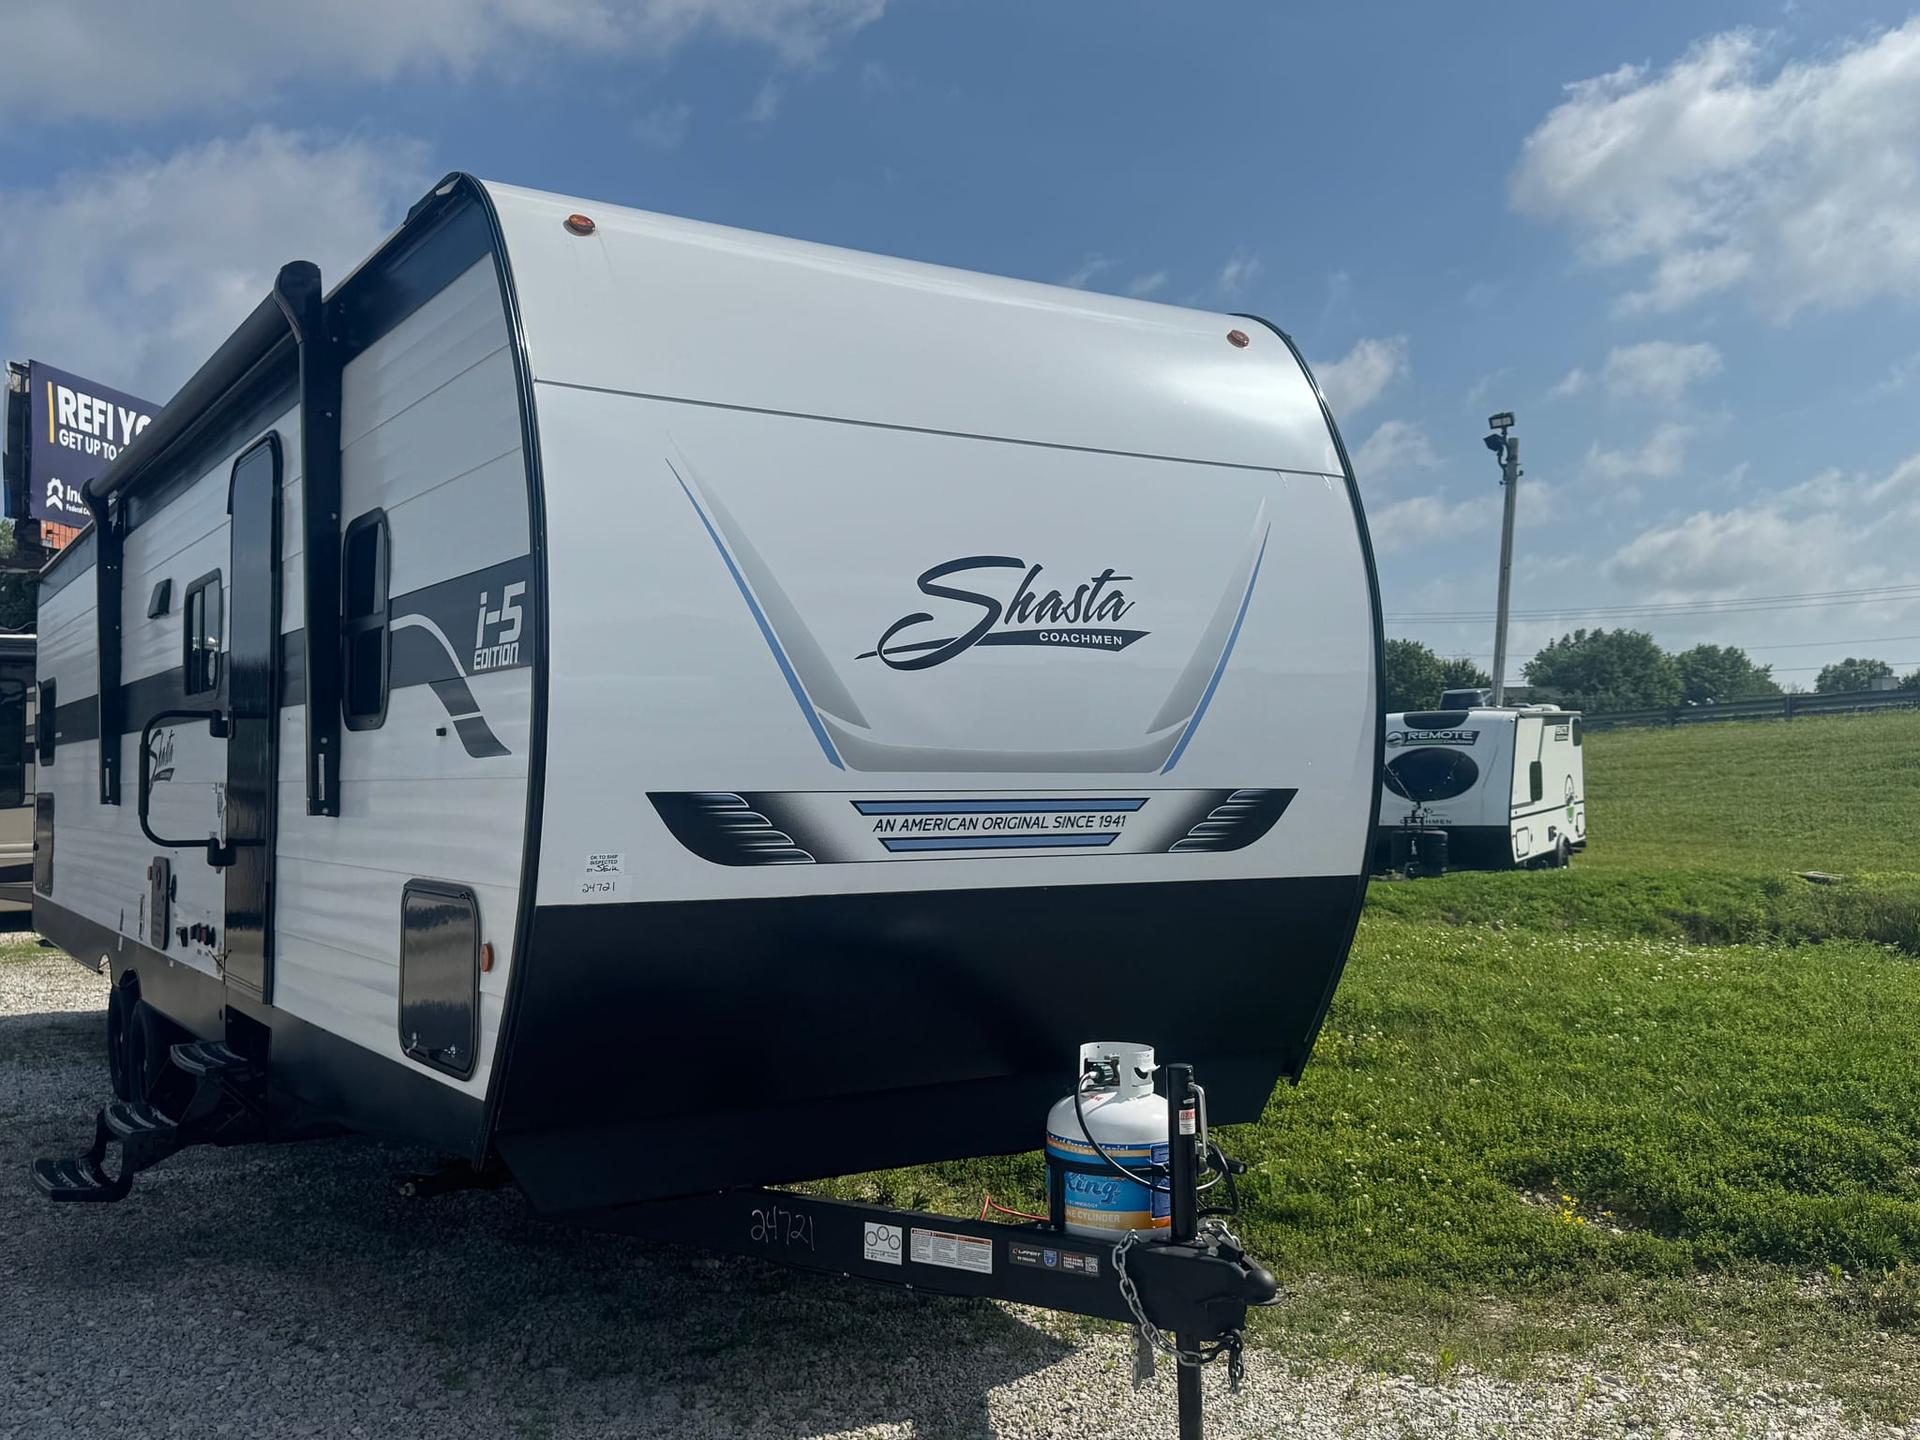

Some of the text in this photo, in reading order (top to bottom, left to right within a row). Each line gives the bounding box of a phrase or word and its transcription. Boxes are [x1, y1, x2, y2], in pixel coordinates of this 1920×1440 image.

[57, 385, 114, 441] REFI
[58, 429, 117, 461] GET UP TO
[874, 555, 1136, 671] Shasta
[1039, 631, 1123, 645] COACHMEN
[1407, 731, 1474, 740] REMOTE
[872, 814, 1127, 832] AN AMERICAN ORIGINAL SINCE 1941
[582, 881, 616, 893] 24721
[750, 1206, 815, 1252] 24721
